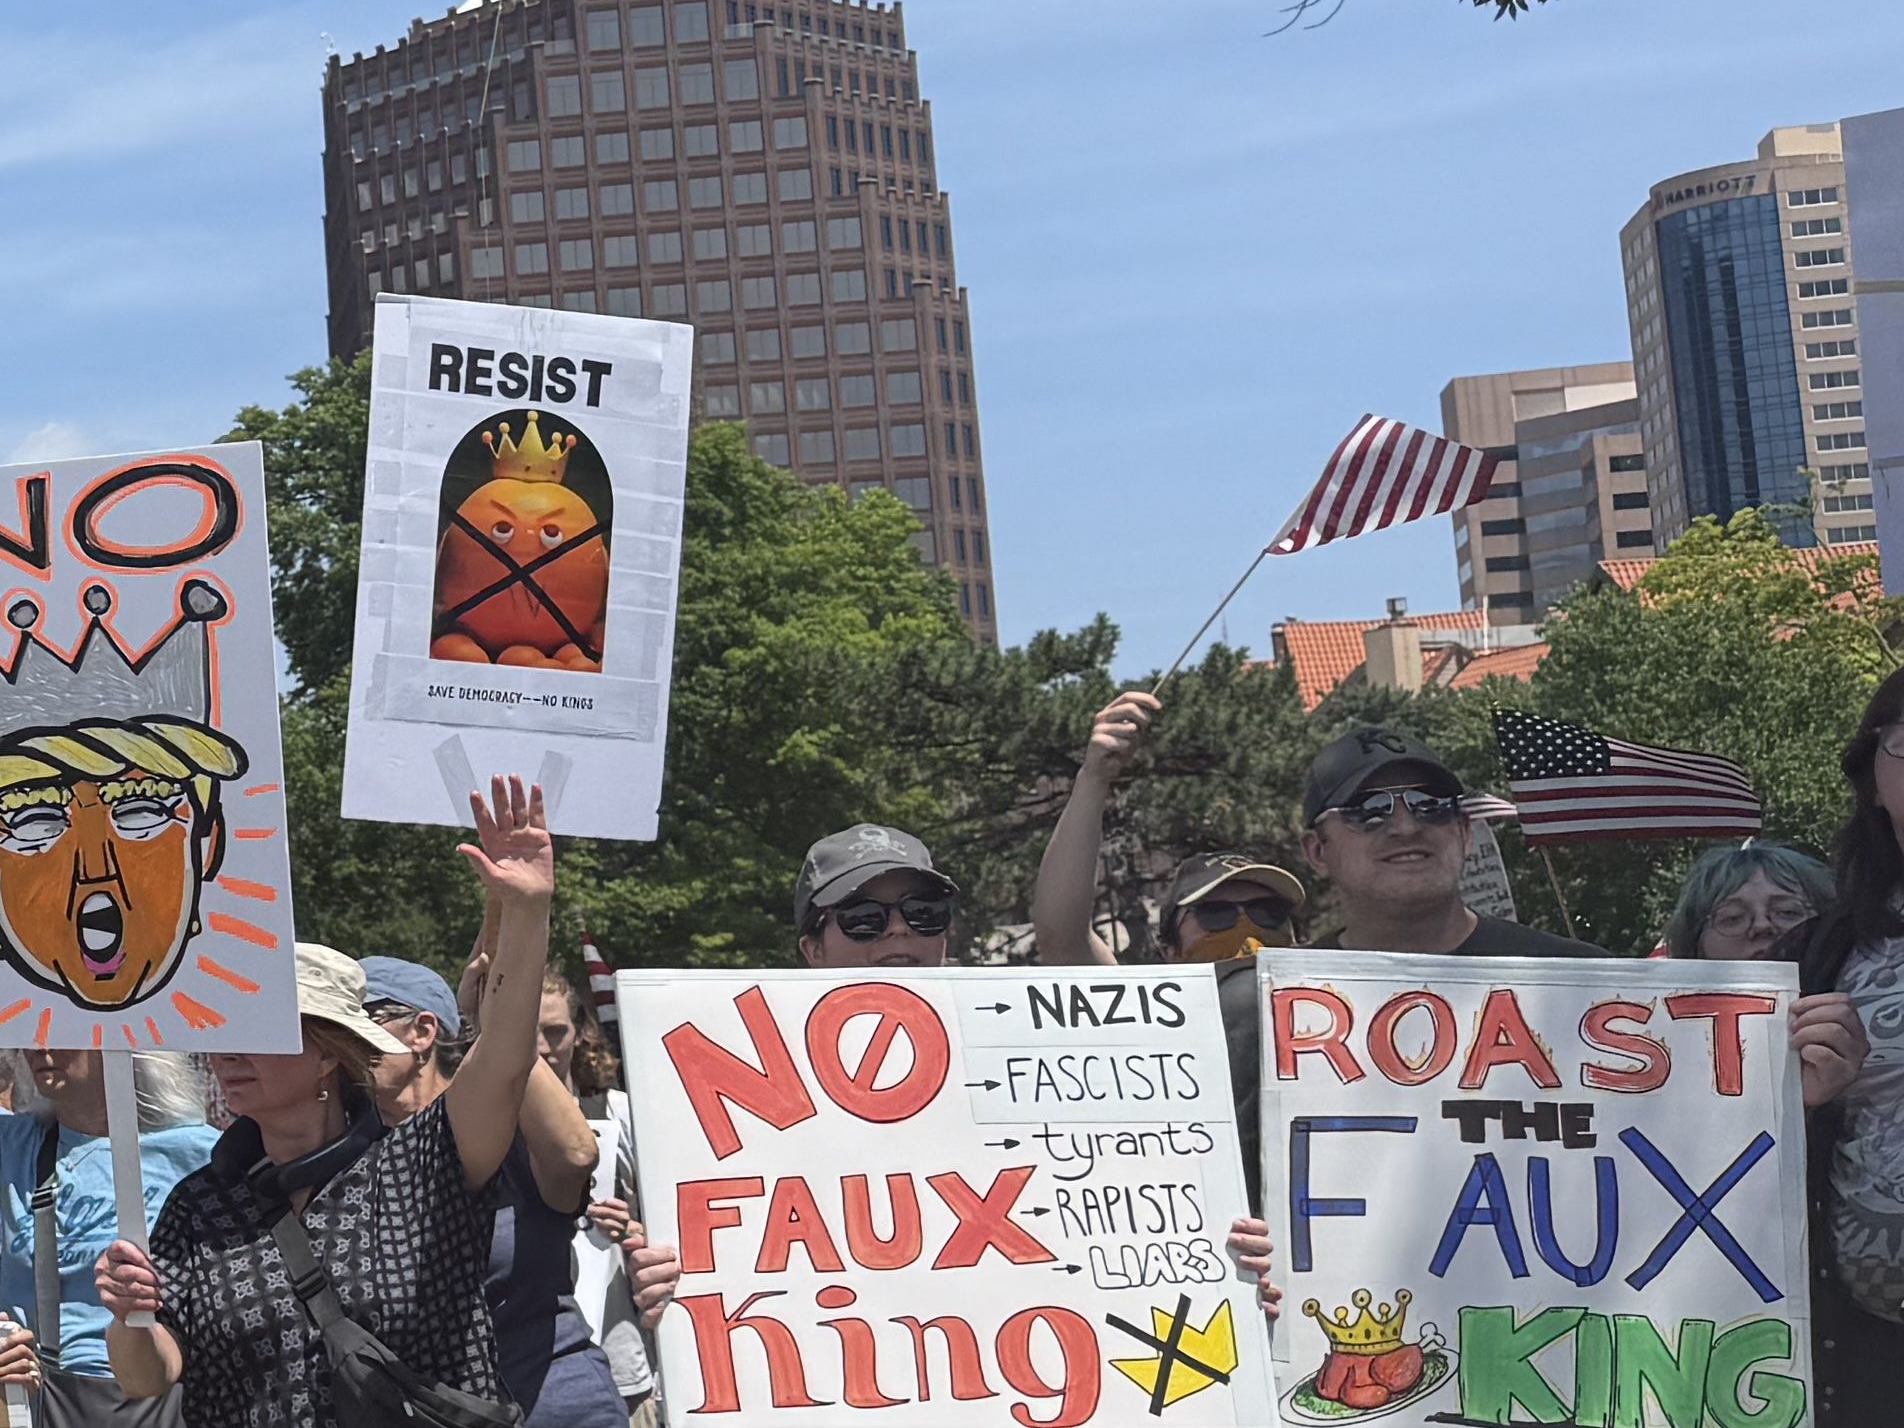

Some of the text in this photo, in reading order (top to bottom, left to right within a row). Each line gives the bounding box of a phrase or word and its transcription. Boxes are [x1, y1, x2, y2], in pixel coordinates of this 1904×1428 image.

[429, 343, 613, 407] RESIST
[428, 685, 594, 710] SAVE KINGS
[1027, 983, 1186, 1029] NAZIS
[1272, 988, 1777, 1096] ROAST
[662, 982, 950, 1160] NO
[1006, 1053, 1200, 1103] FASCISTS
[1032, 1121, 1214, 1181] tyrants
[1442, 1099, 1598, 1149] THE
[676, 1164, 1059, 1274] FAUX
[1055, 1184, 1205, 1239] RAPISTS
[1291, 1115, 1785, 1304] FAUX
[1089, 1239, 1226, 1290] LIARS
